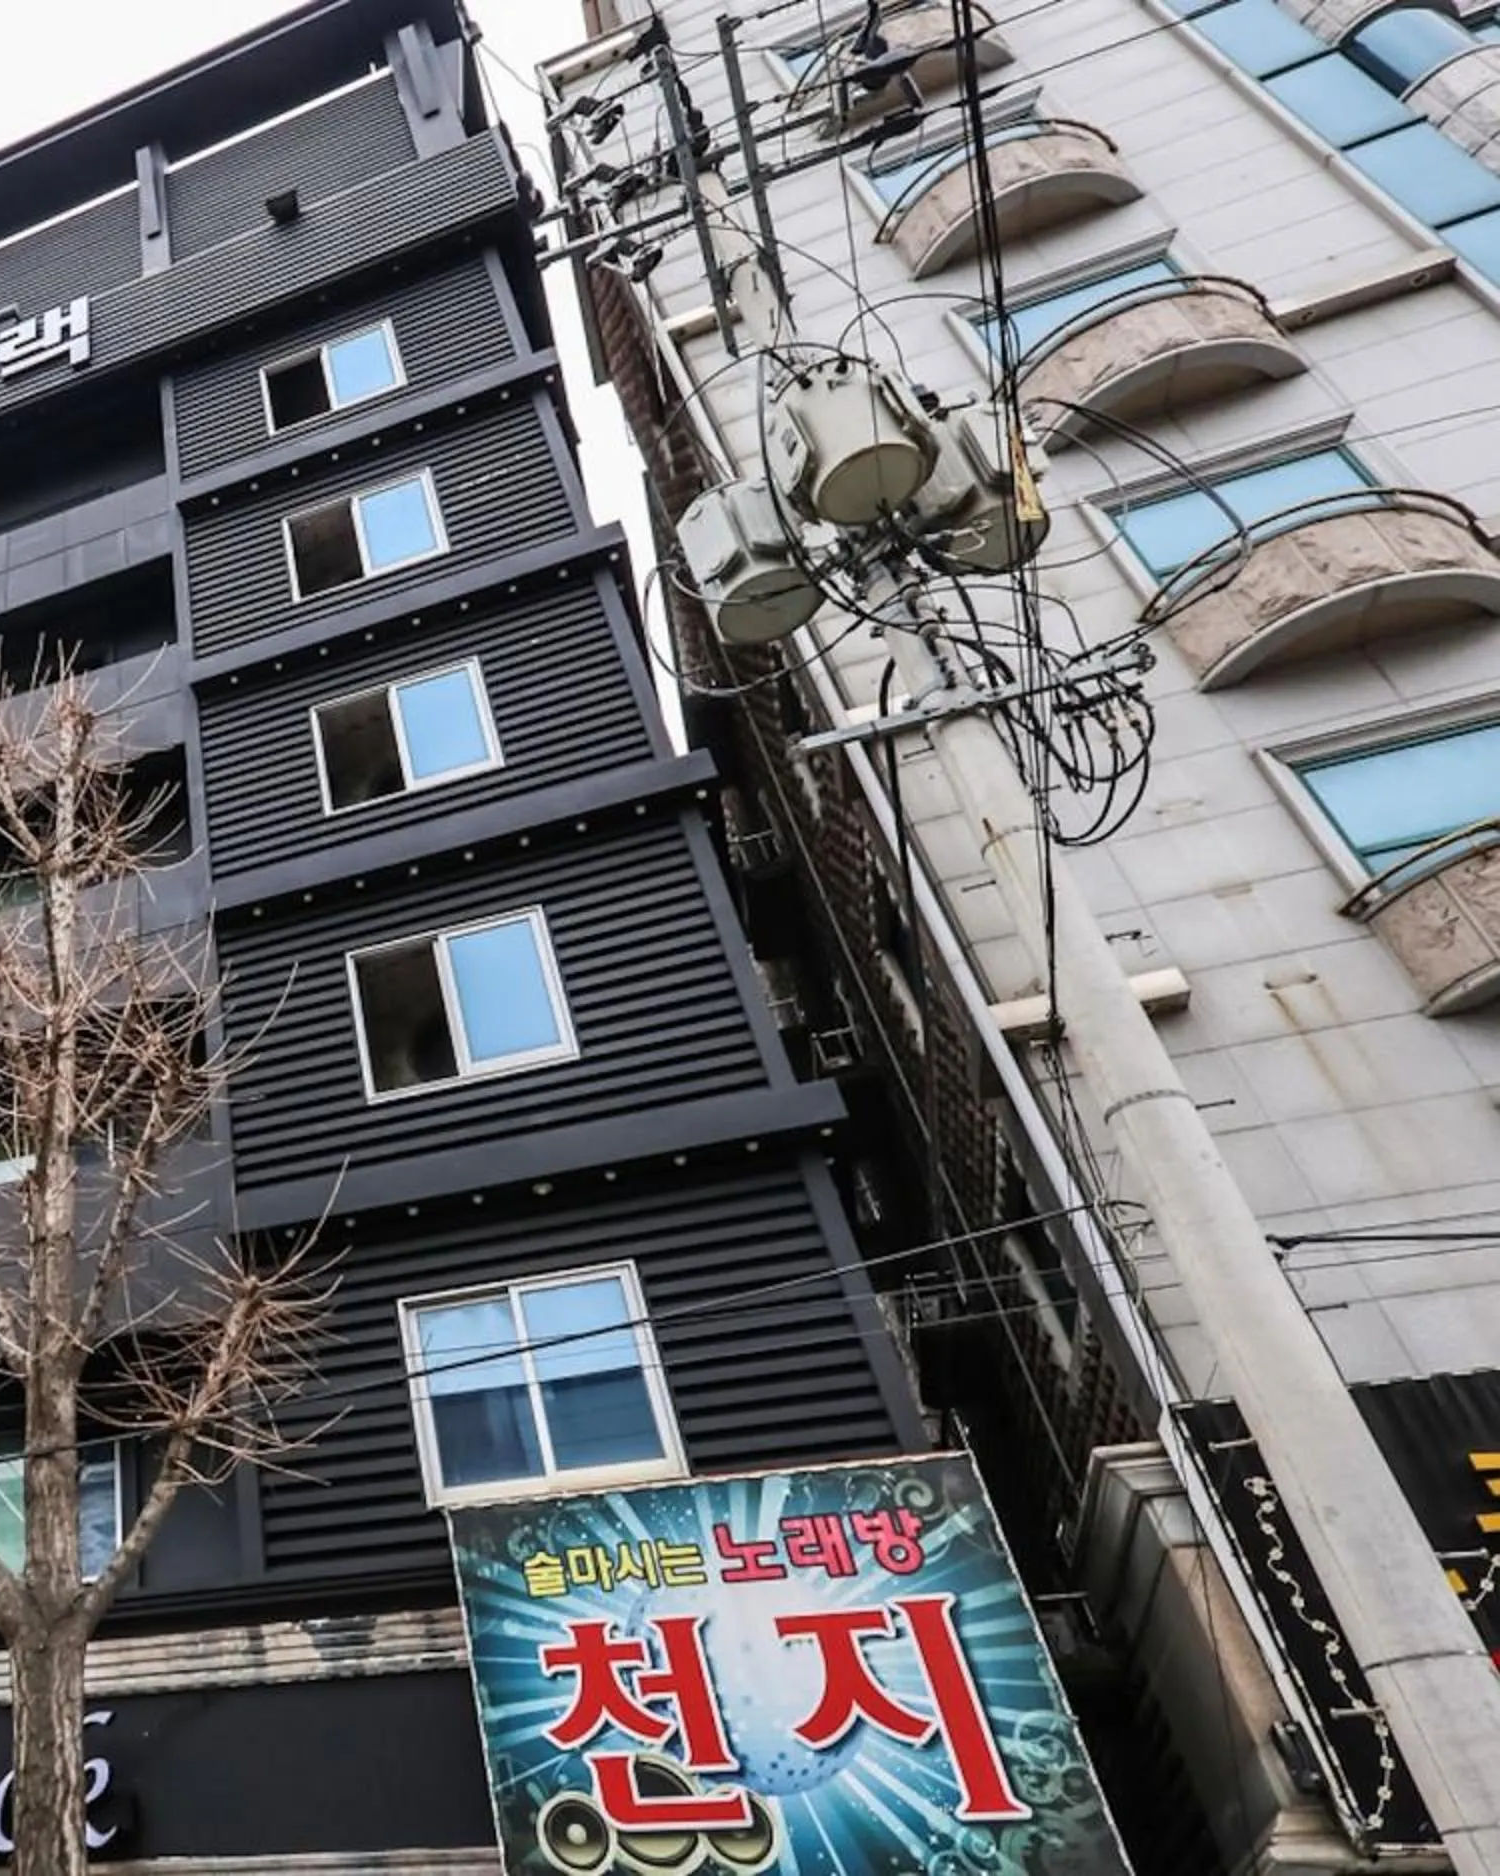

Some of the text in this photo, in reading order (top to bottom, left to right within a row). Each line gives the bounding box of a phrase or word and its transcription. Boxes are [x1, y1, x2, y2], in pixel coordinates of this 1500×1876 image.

[522, 1507, 927, 1599] 술마시는 노래방
[538, 1592, 1035, 1834] 천지
